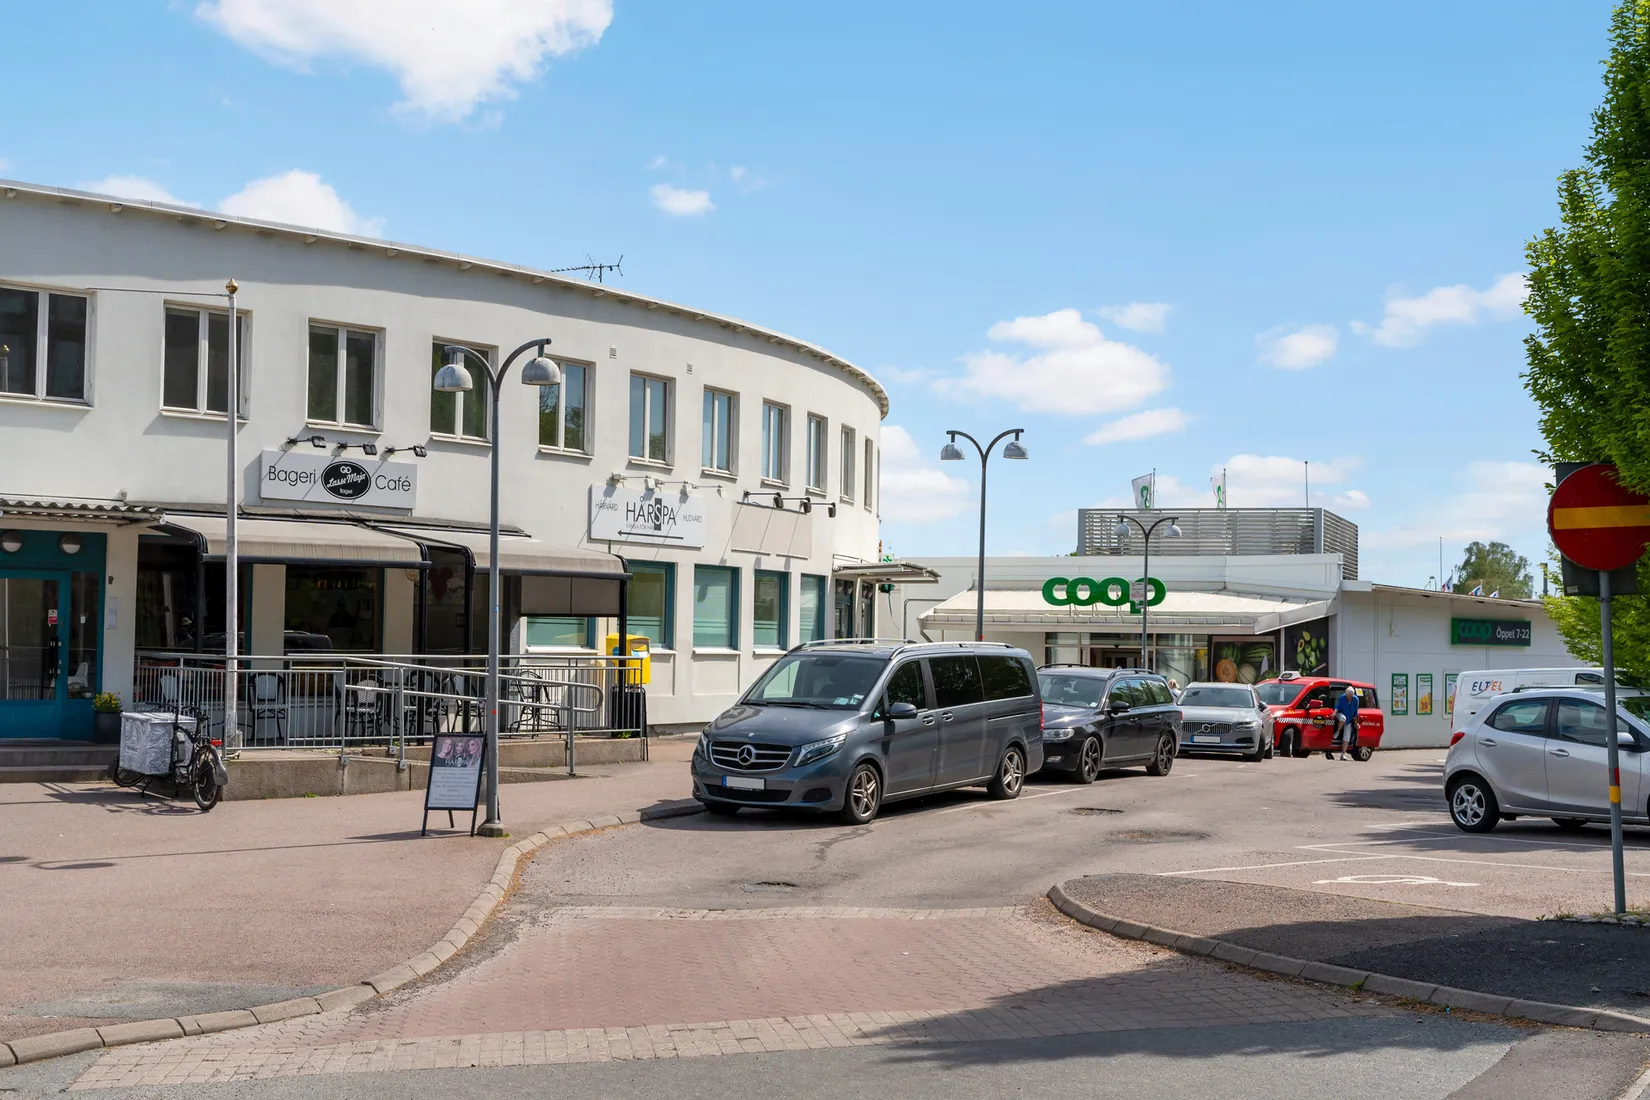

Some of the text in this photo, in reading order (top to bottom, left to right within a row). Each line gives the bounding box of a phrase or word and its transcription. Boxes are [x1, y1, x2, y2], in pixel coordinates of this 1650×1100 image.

[268, 465, 316, 487] Bageri
[374, 474, 411, 492] Café
[625, 496, 677, 526] HÅRSPA
[1042, 577, 1167, 614] coop
[1459, 622, 1530, 642] coop Öppet 7-22
[1471, 680, 1503, 692] ELTEL
